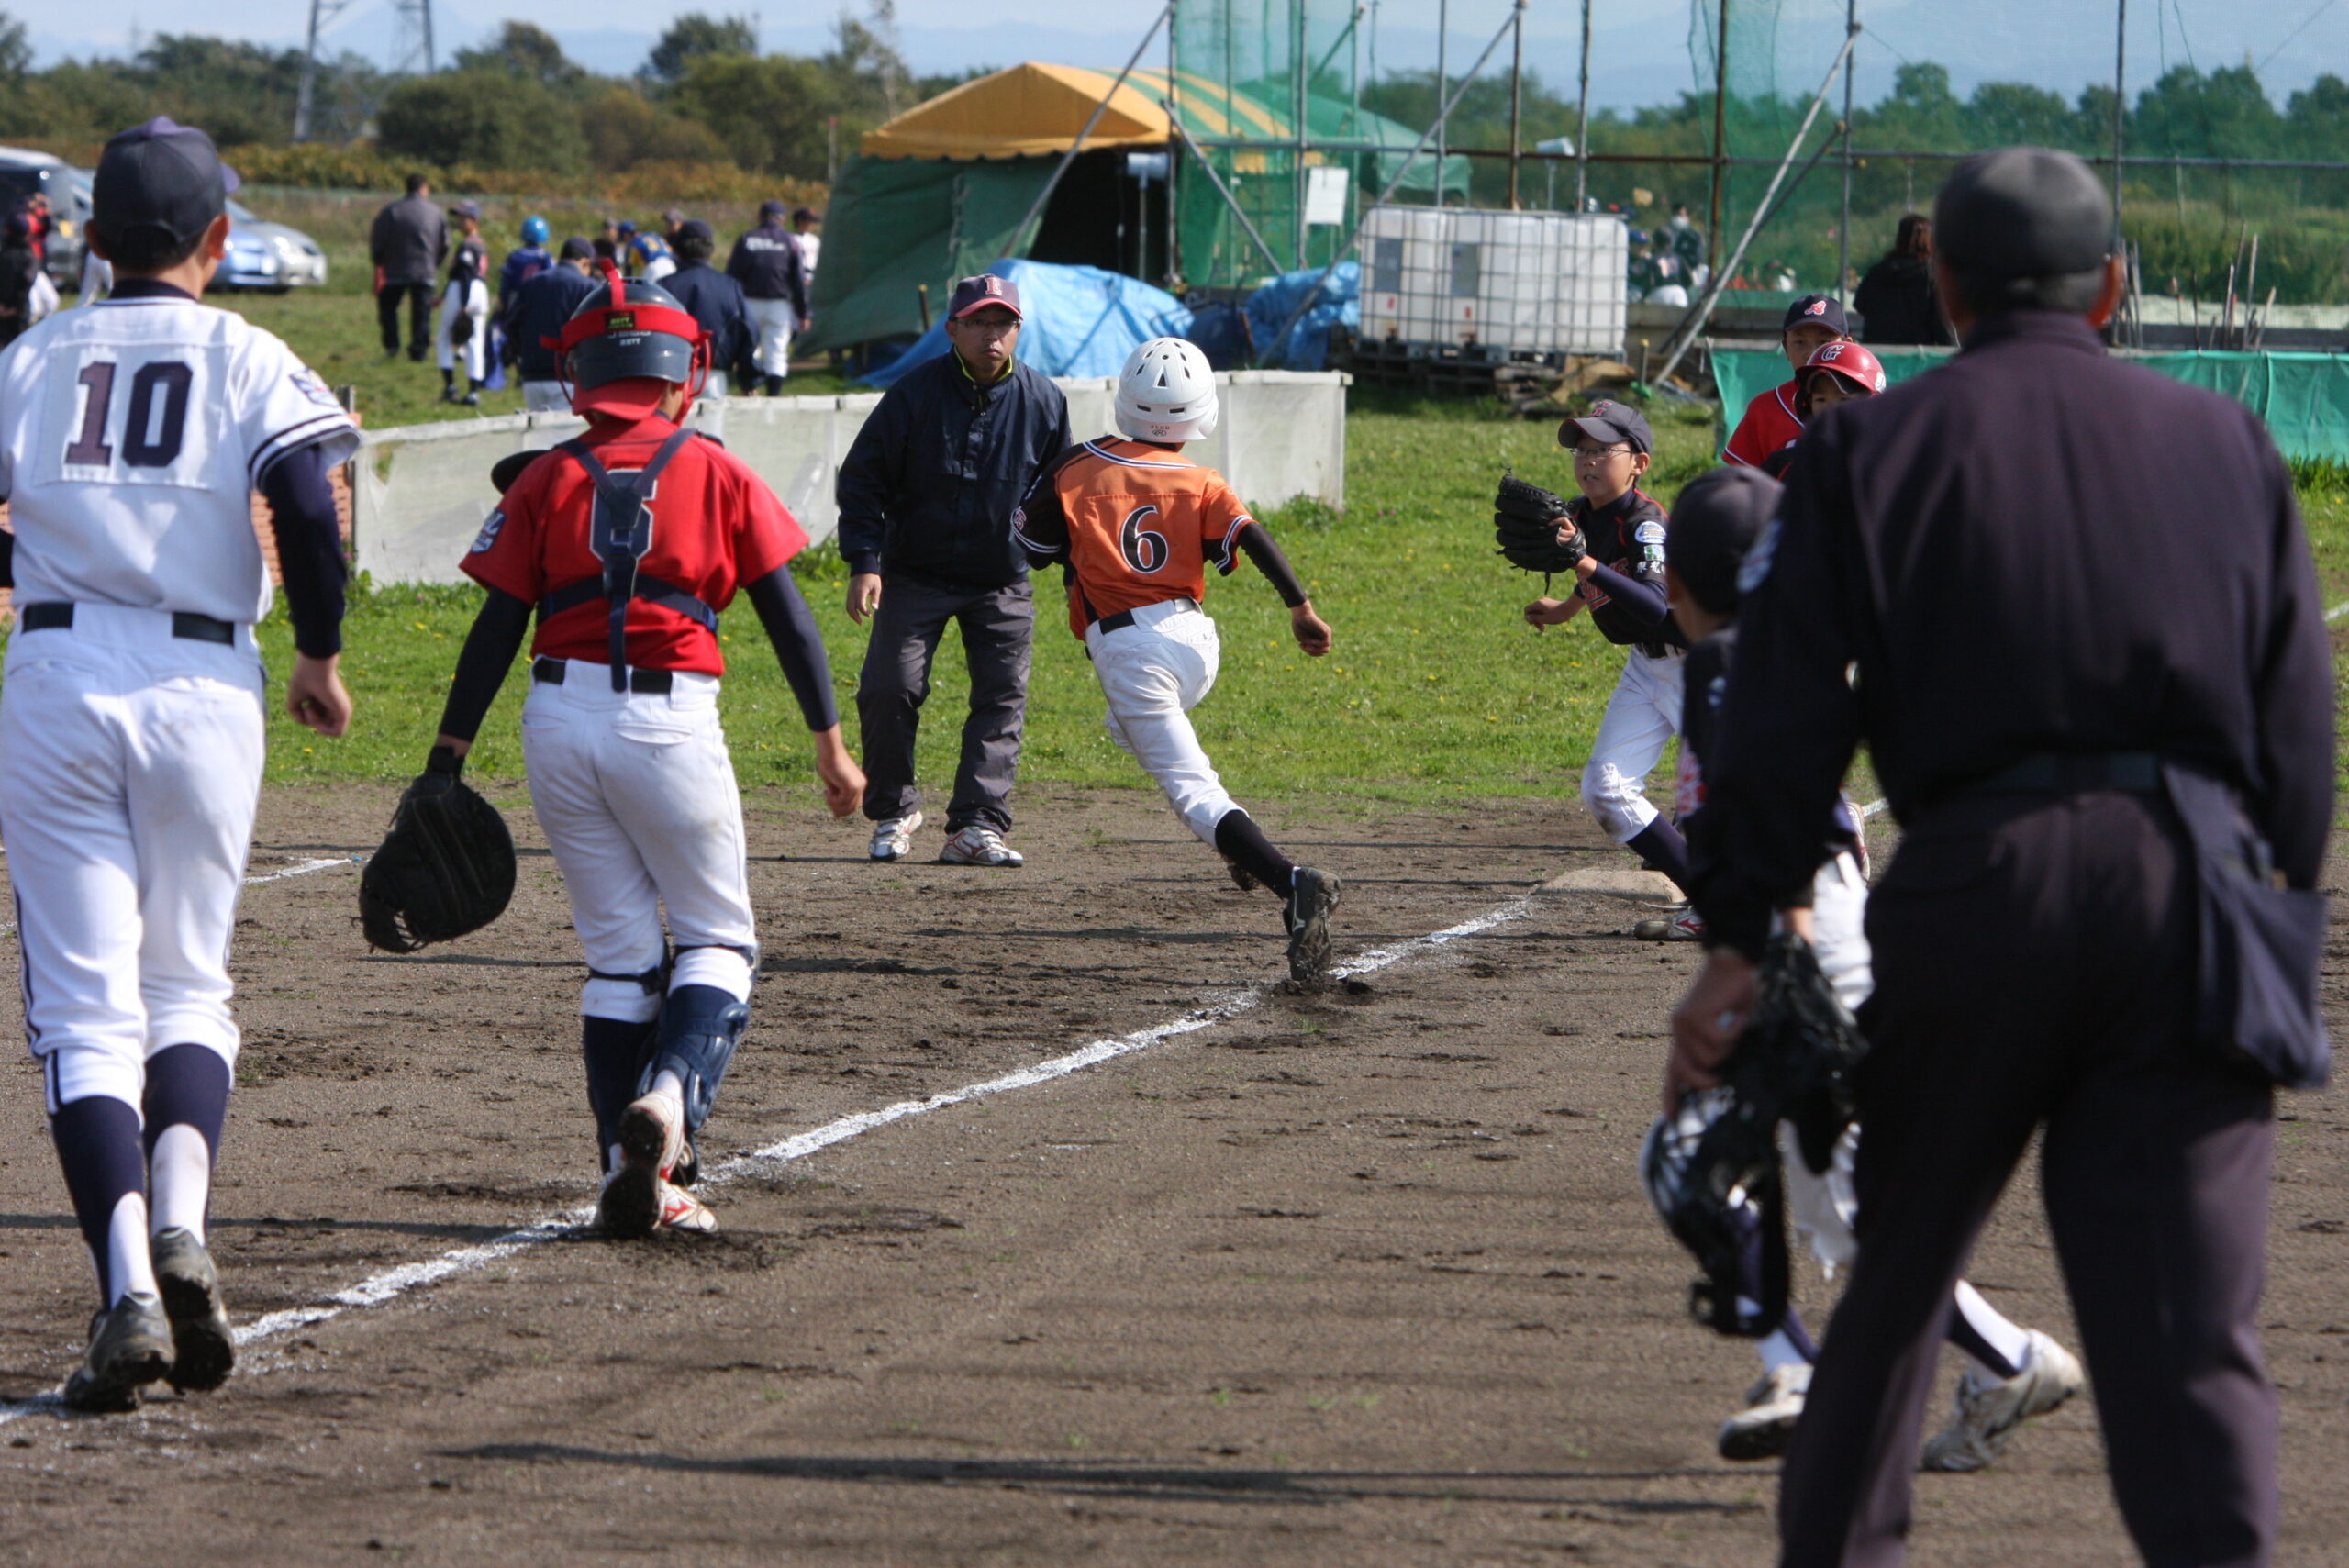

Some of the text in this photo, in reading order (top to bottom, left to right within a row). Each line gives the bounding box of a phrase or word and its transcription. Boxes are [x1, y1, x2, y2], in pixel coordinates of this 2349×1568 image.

[1821, 345, 1845, 361] G
[64, 361, 194, 468] 10
[1120, 505, 1169, 574] 6
